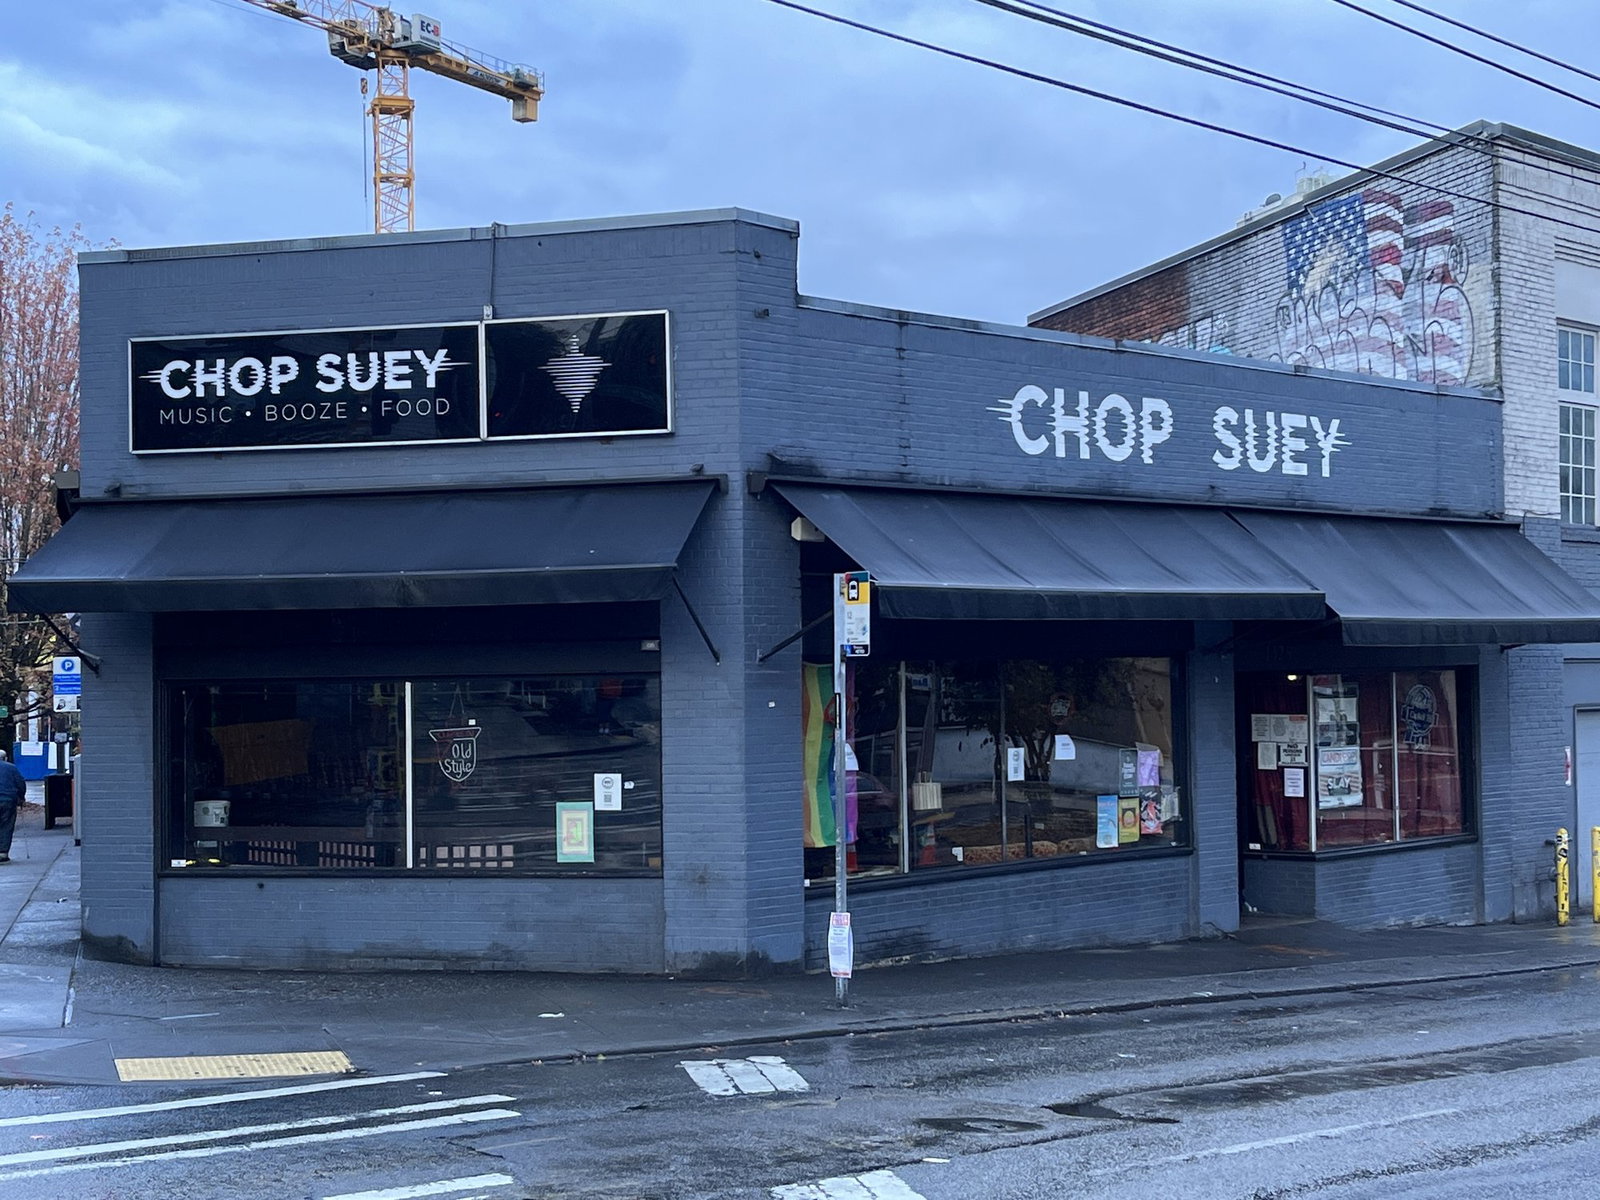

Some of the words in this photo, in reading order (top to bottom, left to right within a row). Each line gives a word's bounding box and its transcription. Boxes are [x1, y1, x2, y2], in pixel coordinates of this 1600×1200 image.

[139, 355, 300, 399] CHOP
[315, 348, 472, 394] SUEY
[159, 406, 233, 425] MUSIC
[264, 402, 348, 422] BOOZE
[380, 397, 451, 417] FOOD
[986, 384, 1173, 465] CHOP
[1211, 405, 1353, 478] SUEY
[452, 743, 471, 758] Old
[445, 759, 471, 778] Style
[1327, 777, 1351, 789] SLAY
